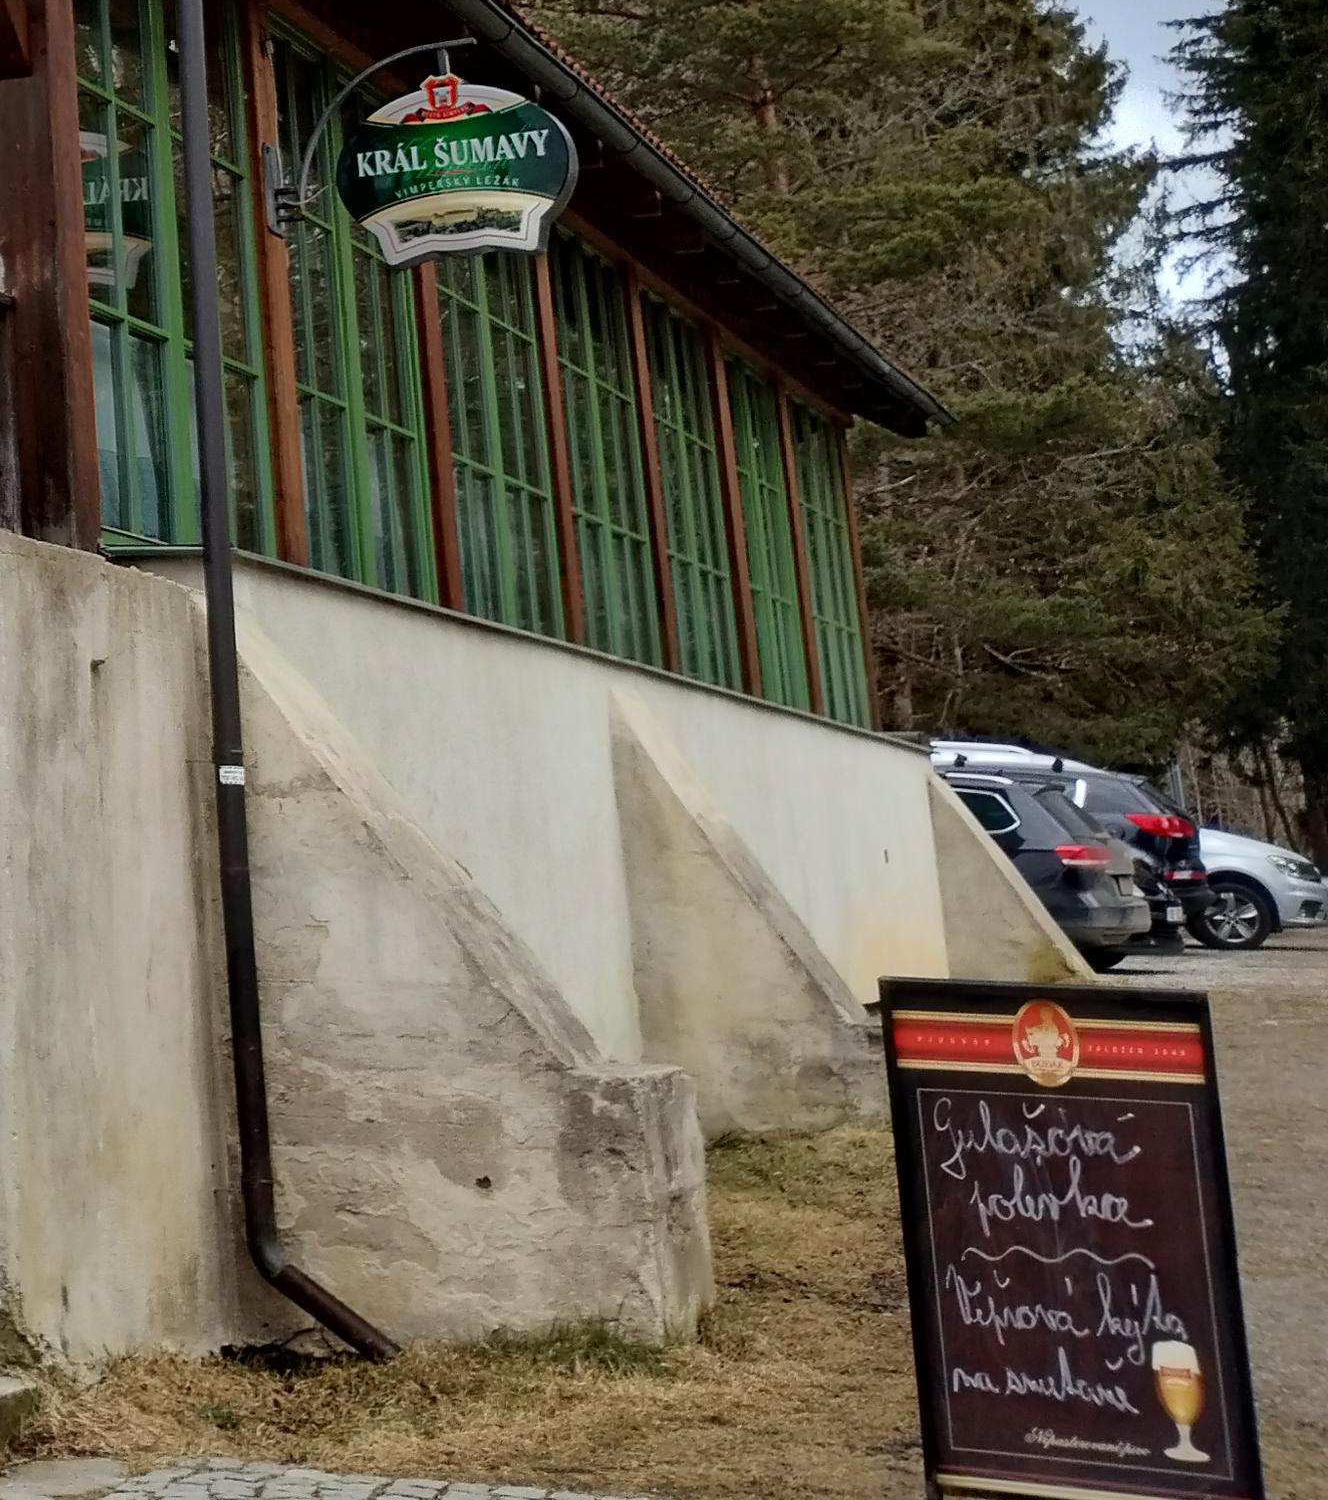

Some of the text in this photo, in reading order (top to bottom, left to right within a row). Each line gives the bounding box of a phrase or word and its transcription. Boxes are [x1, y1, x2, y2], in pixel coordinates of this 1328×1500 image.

[357, 129, 549, 178] KRÁL ŠUMAVY
[945, 1264, 1188, 1366] Vepřová kýta
[953, 1367, 1000, 1393] na
